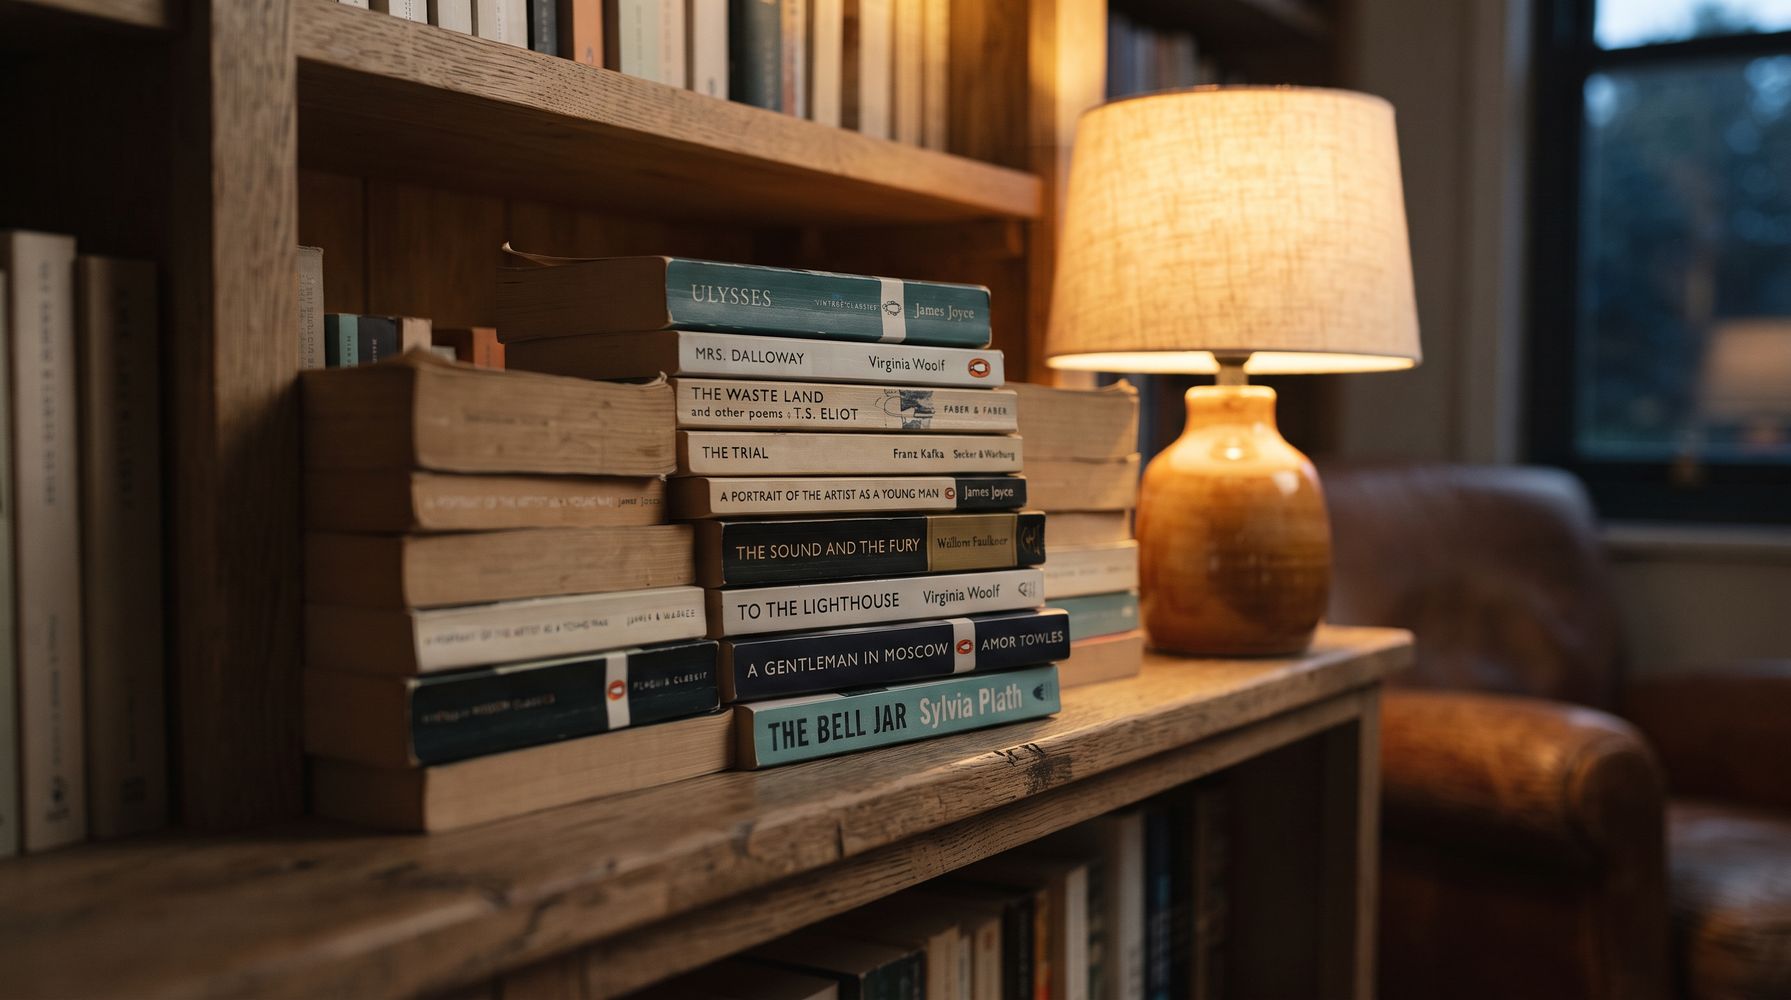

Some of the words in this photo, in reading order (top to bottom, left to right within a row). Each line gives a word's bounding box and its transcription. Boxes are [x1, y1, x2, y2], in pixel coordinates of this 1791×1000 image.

[691, 284, 772, 307] ULYSSES
[914, 303, 945, 318] James
[947, 305, 975, 322] Joyce
[695, 347, 727, 362] MRS.
[731, 349, 804, 365] DALLOWAY
[868, 355, 911, 373] Virginia
[912, 356, 945, 372] Woolf
[691, 387, 722, 401] THE
[726, 388, 778, 402] WASTE
[784, 390, 824, 404] LAND
[691, 407, 711, 418] and
[714, 407, 745, 419] other
[749, 409, 783, 421] poems
[793, 407, 816, 420] T.S.
[821, 408, 858, 421] ELIOT
[944, 405, 970, 414] FABER
[973, 406, 979, 414] &
[983, 406, 1007, 415] FABER
[702, 446, 729, 459] THE
[732, 447, 769, 460] TRIAL
[893, 448, 918, 460] Franz
[920, 448, 945, 460] Kafka
[953, 449, 977, 459] Secker
[720, 491, 728, 502] A
[731, 490, 782, 502] PORTRAIT
[785, 490, 800, 501] OF
[802, 489, 822, 501] THE
[824, 488, 856, 500] ARTIST
[859, 488, 871, 499] AS
[873, 488, 880, 499] A
[882, 487, 916, 499] YOUNG
[918, 487, 939, 498] MAN
[964, 485, 989, 498] James
[991, 486, 1014, 500] Joyce
[736, 545, 766, 560] THE
[770, 543, 822, 559] SOUND
[826, 541, 856, 556] AND
[859, 539, 886, 554] THE
[889, 537, 921, 552] FURY
[923, 589, 965, 605] Virginia
[968, 585, 1001, 600] Woolf
[737, 604, 761, 621] TO
[766, 600, 798, 618] THE
[803, 593, 900, 614] LIGHTHOUSE
[981, 636, 1017, 651] AMOR
[1019, 630, 1064, 647] TOWLES
[747, 663, 758, 679] A
[764, 652, 858, 676] GENTLEMAN
[864, 650, 879, 665] IN
[884, 642, 949, 663] MOSCOW
[919, 692, 973, 729] Sylvia
[979, 683, 1022, 716] Plath
[767, 717, 809, 752] THE
[817, 711, 866, 743] BELL
[873, 702, 907, 734] JAR
